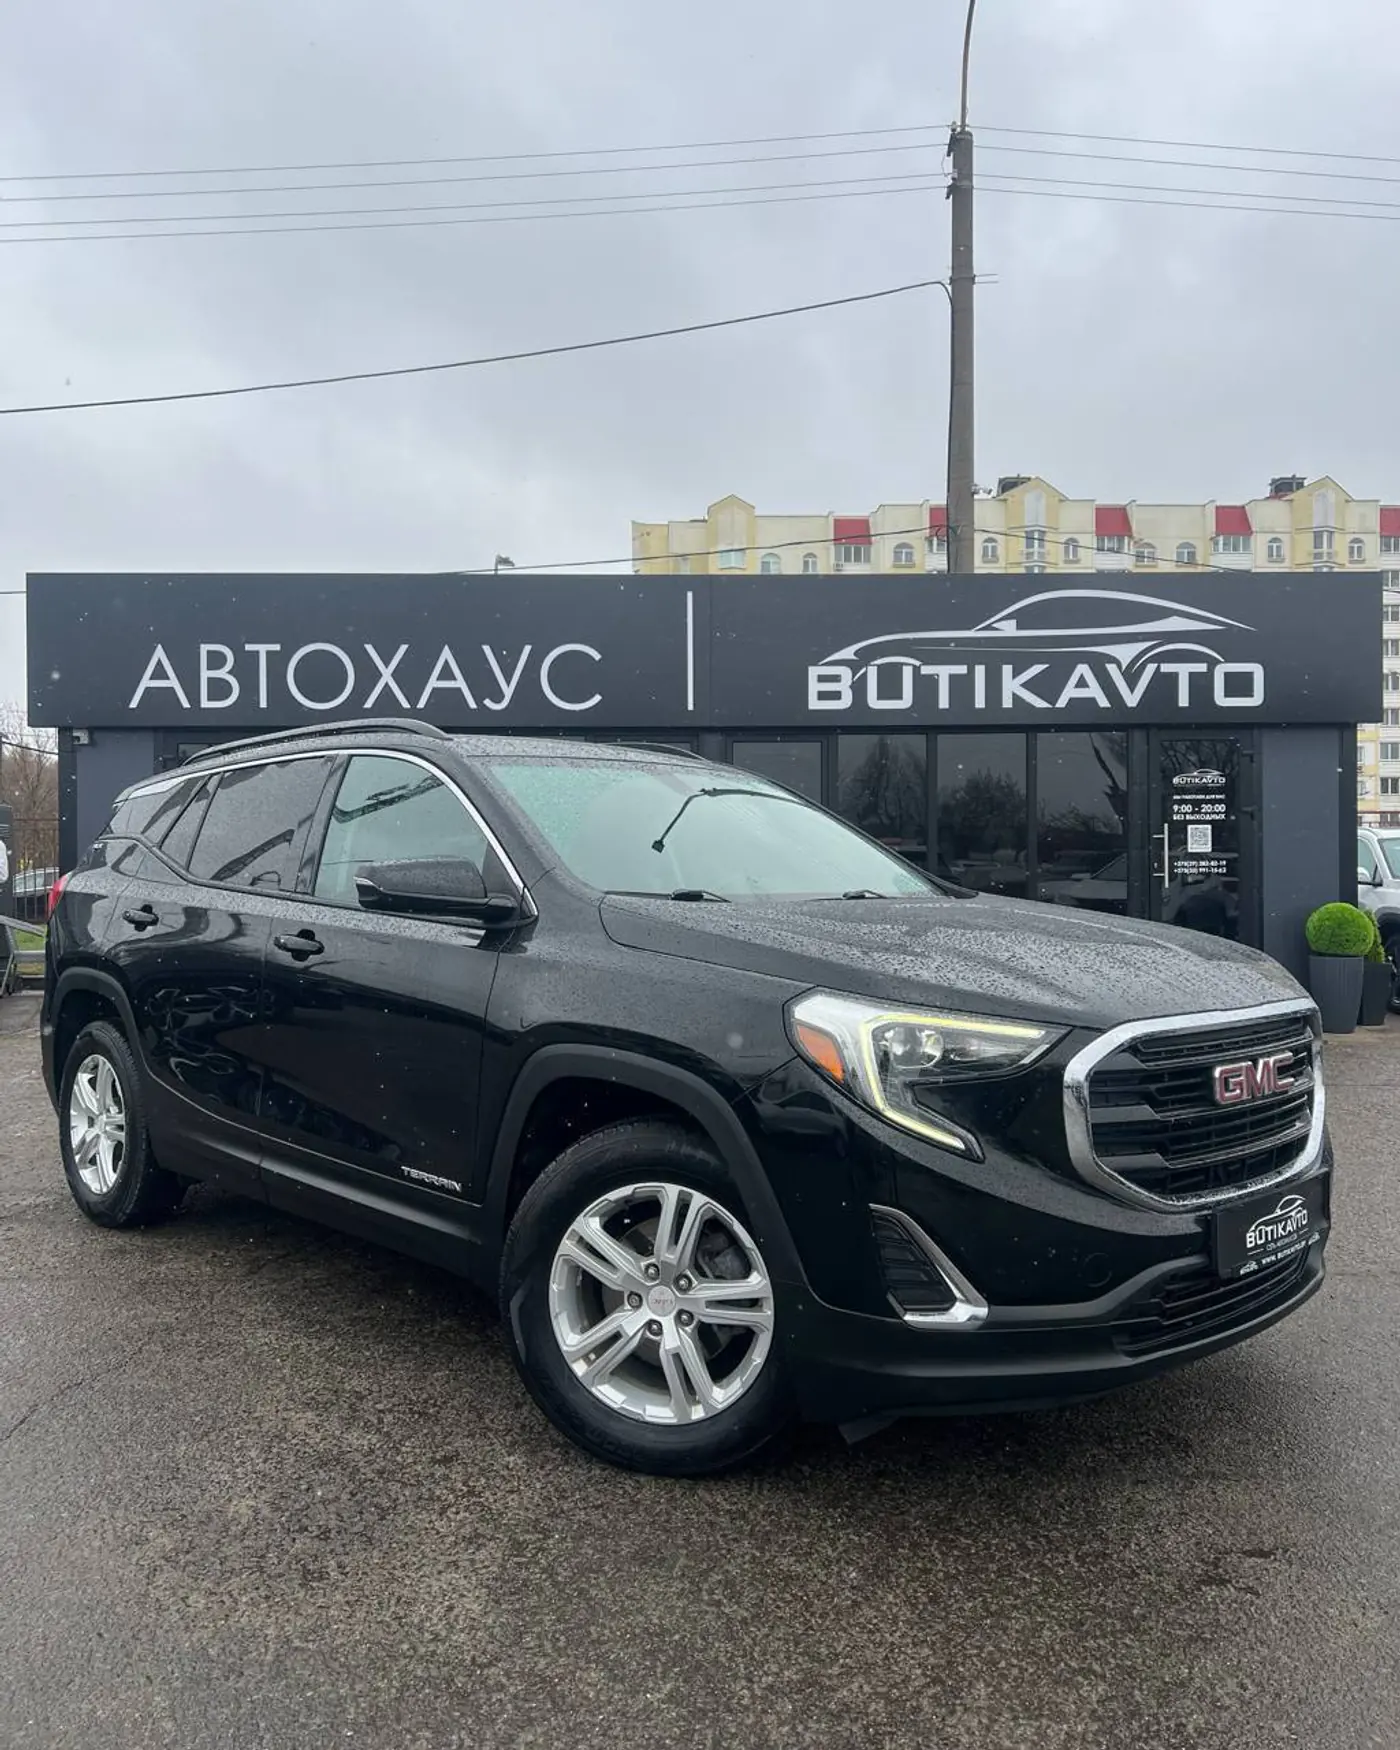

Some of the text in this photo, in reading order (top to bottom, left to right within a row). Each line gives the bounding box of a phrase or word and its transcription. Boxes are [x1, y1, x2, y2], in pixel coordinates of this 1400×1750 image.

[129, 642, 603, 711] АВТОХАУС
[807, 662, 1266, 711] BUTIKAVTO
[1173, 804, 1193, 813] 9:00
[1201, 804, 1226, 812] 20:00
[1214, 1051, 1294, 1104] GMC
[400, 1165, 462, 1192] TERRAIN
[1245, 1209, 1308, 1248] BUTIKAVTO
